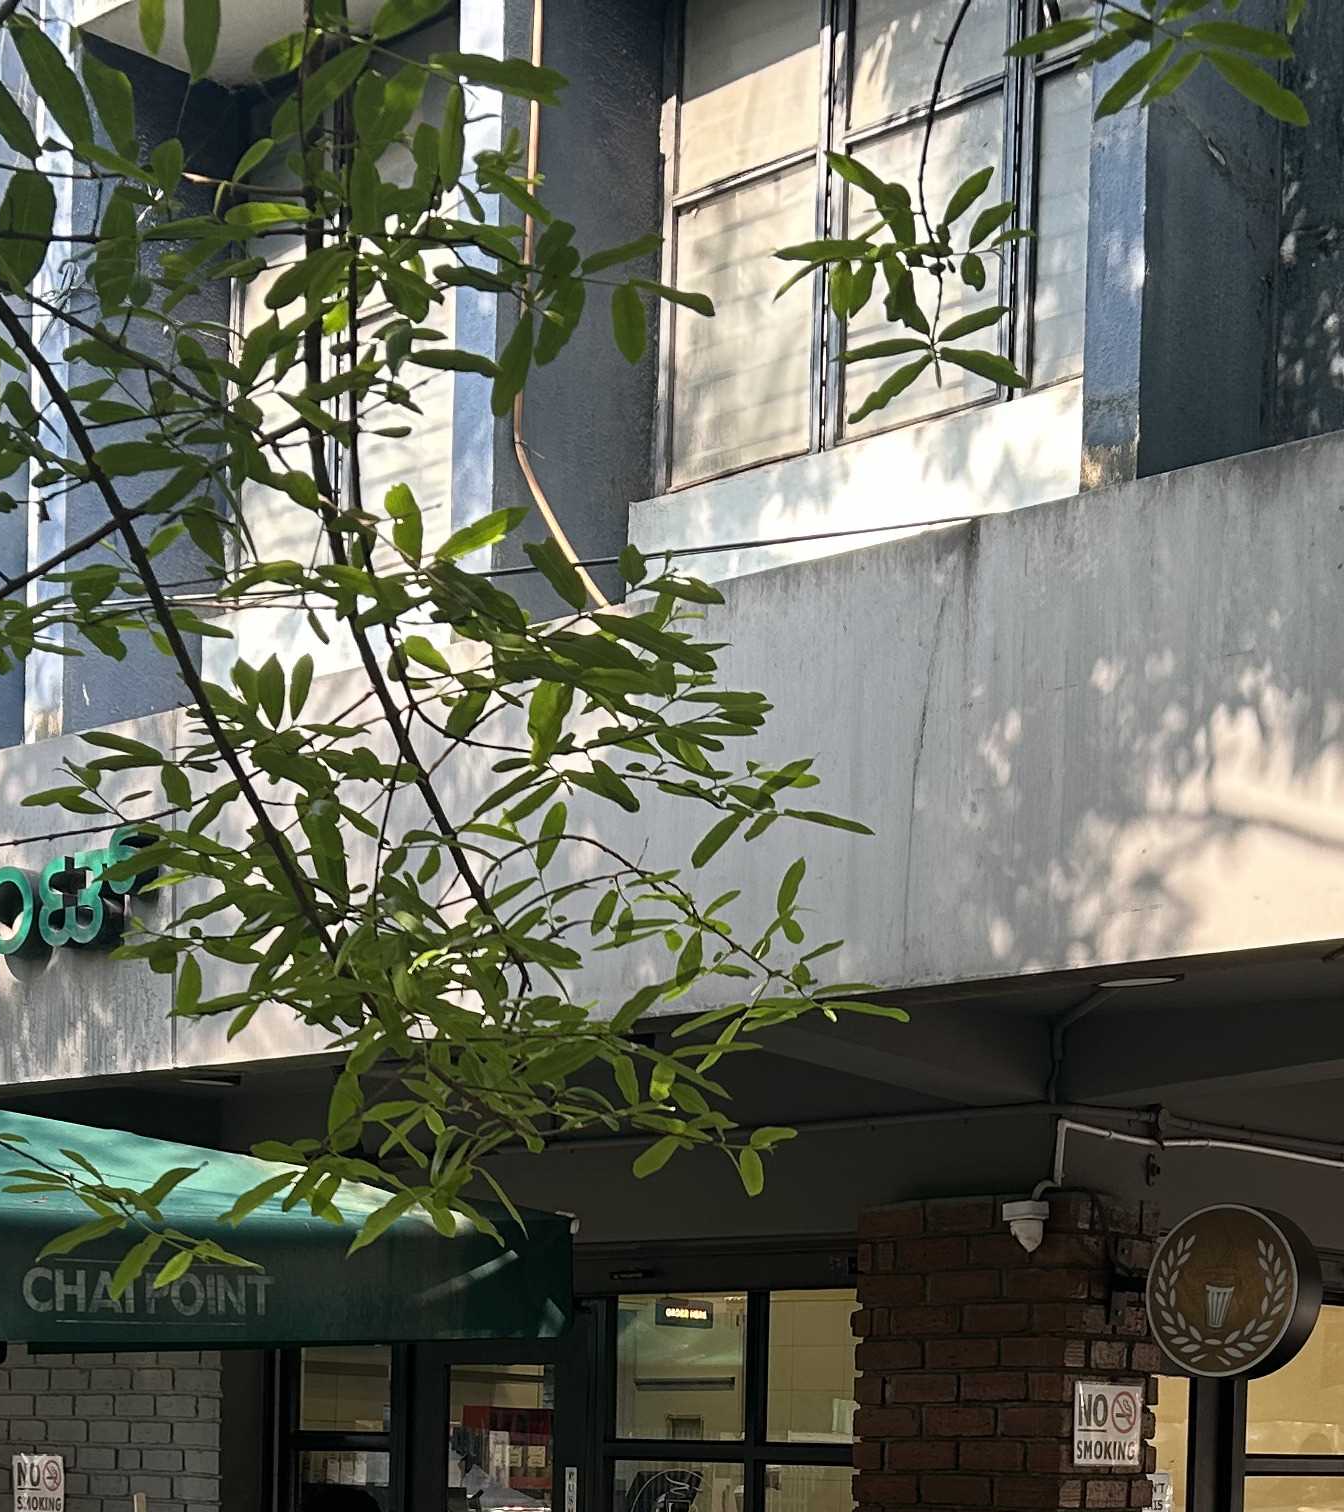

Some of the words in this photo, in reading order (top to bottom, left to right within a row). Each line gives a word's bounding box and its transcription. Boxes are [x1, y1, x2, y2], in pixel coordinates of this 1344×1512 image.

[1077, 1393, 1108, 1428] NO
[1076, 1439, 1136, 1462] SMOKING
[17, 1462, 41, 1488] NO
[17, 1495, 62, 1512] SMOKING
